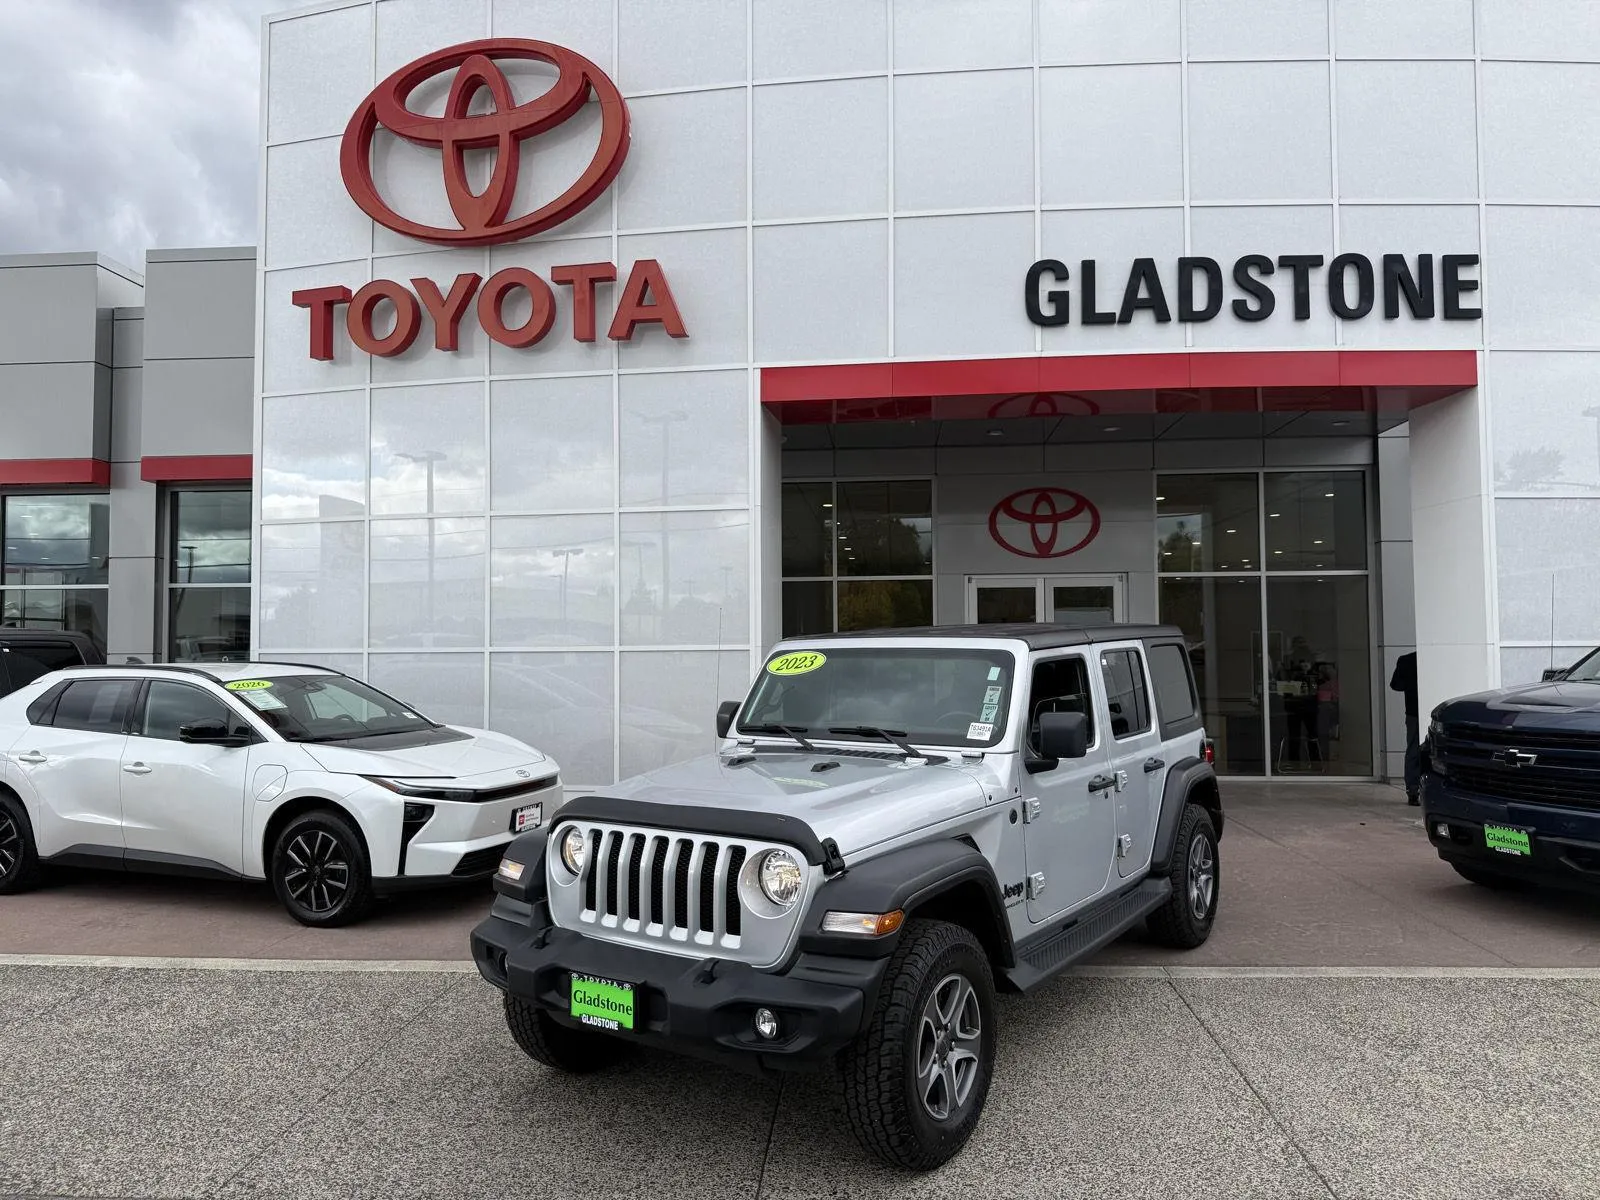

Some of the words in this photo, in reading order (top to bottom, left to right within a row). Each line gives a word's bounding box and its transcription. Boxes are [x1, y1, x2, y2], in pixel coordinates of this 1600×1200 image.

[1025, 253, 1482, 327] GLADSTONE
[292, 259, 689, 362] TOYOTA
[775, 655, 818, 671] 2023
[233, 681, 265, 689] 2026
[1487, 833, 1528, 847] Gladstone
[1002, 881, 1024, 900] Jeep
[583, 975, 619, 988] TOYOTA
[573, 989, 633, 1016] Gladstone
[581, 1013, 619, 1030] GLADSTONE
